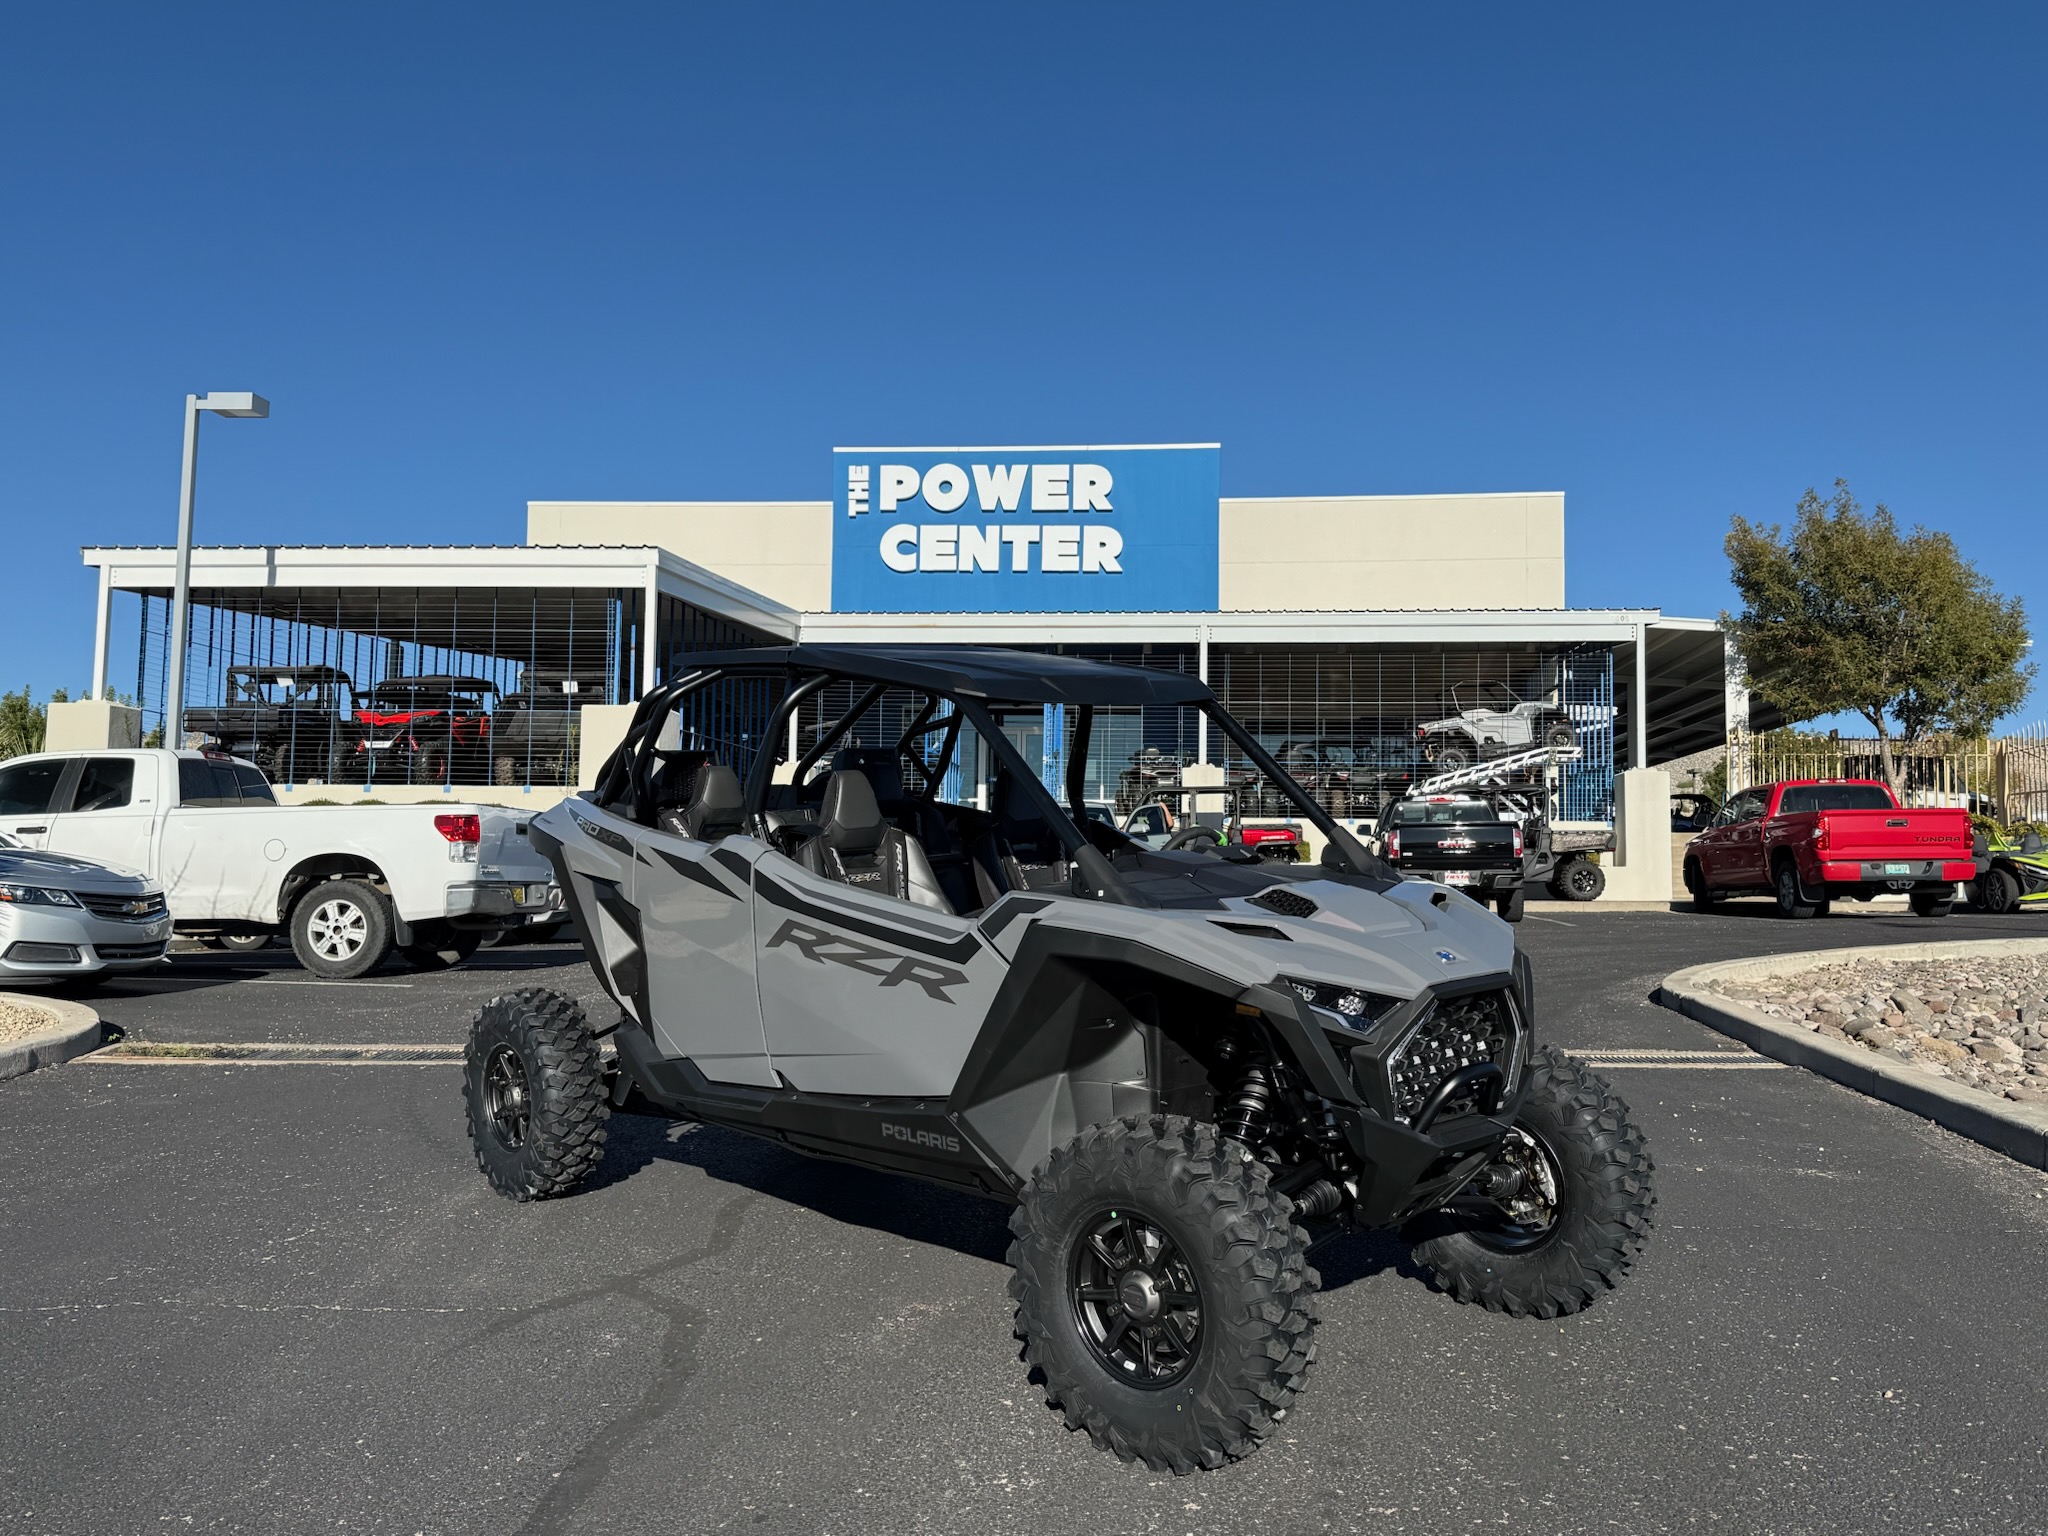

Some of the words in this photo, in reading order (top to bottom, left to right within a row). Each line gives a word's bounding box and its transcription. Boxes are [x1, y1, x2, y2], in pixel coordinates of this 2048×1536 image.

[848, 464, 870, 518] THE
[879, 463, 1113, 513] POWER
[879, 523, 1124, 573] CENTER
[577, 816, 600, 836] PRO
[600, 830, 623, 843] XP
[764, 918, 970, 1005] RZR
[881, 1122, 960, 1153] POLARIS
